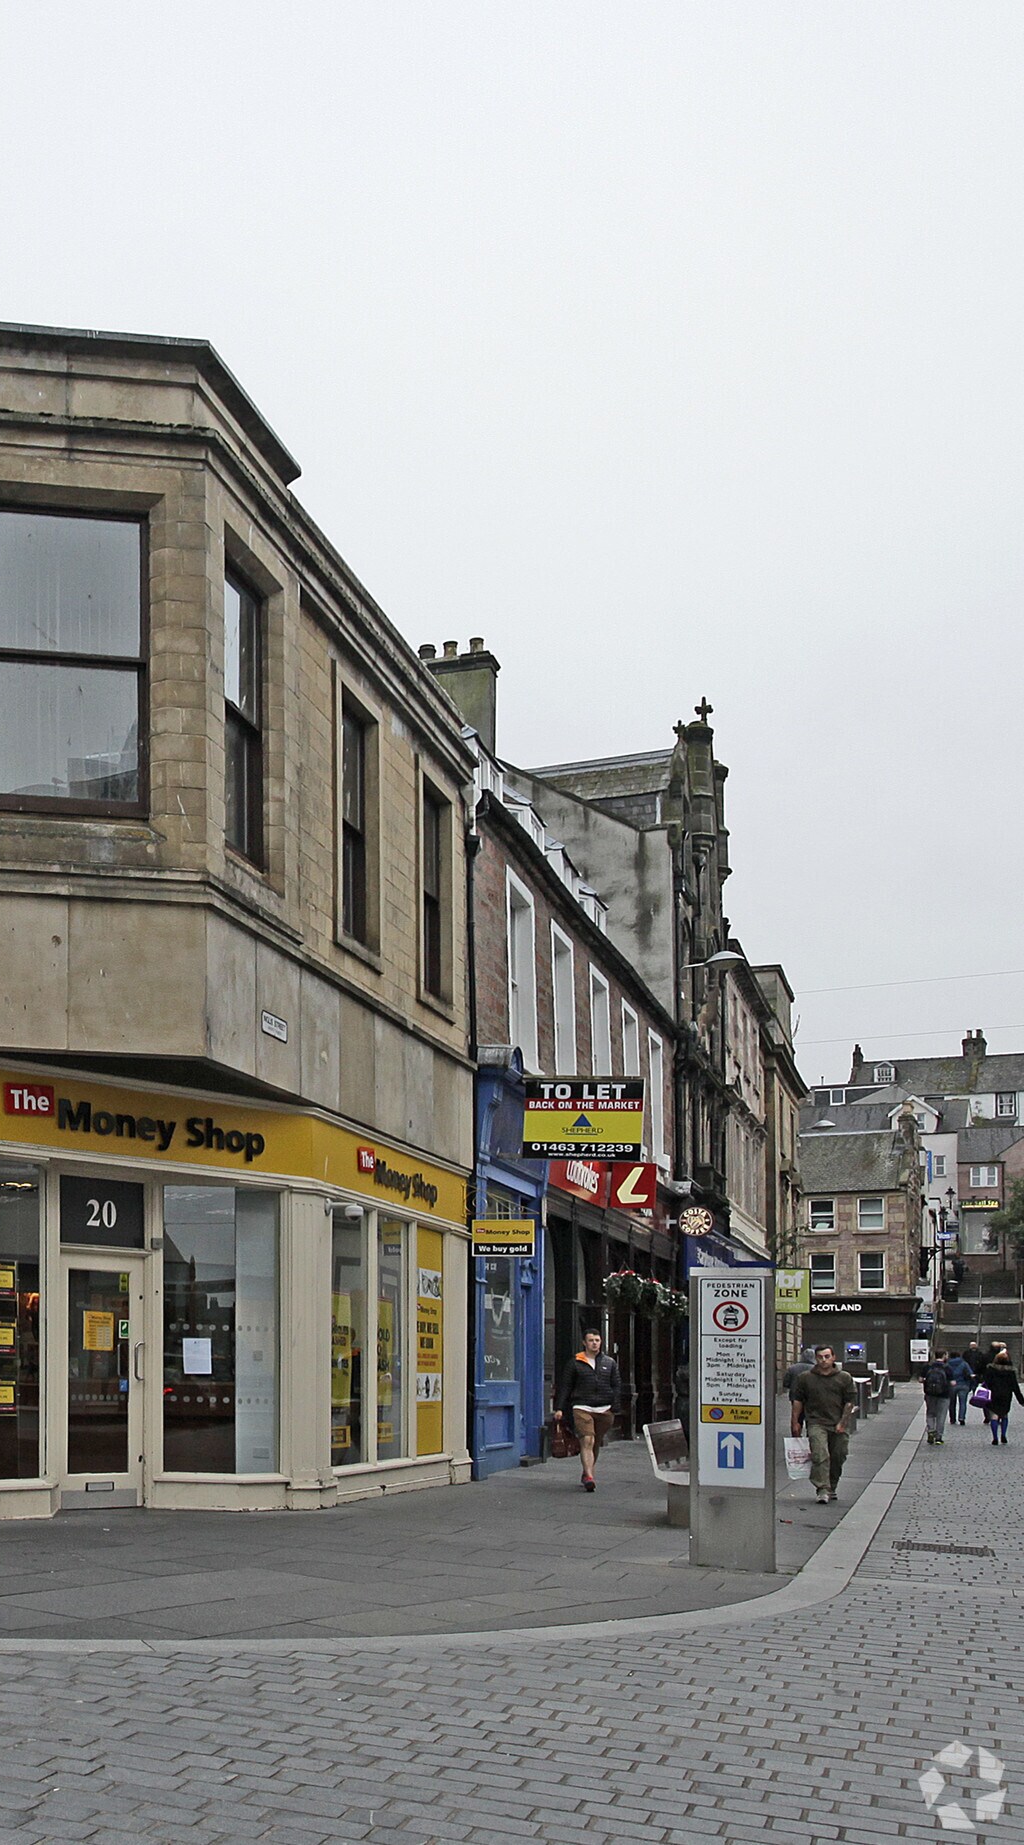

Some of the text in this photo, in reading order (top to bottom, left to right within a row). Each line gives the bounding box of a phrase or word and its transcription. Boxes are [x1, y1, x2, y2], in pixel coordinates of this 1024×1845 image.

[540, 1084, 626, 1100] TO LET
[529, 1101, 640, 1110] BACK ON THE MARKET
[10, 1089, 265, 1162] The Money Shop
[531, 1143, 634, 1153] 01463 712239
[361, 1151, 438, 1208] The Money Shop
[86, 1199, 117, 1228] 20
[683, 1207, 708, 1218] COSTA
[681, 1222, 710, 1235] COFFEE
[492, 1245, 508, 1254] buy
[509, 1245, 528, 1254] gold
[714, 1289, 748, 1298] ZONE
[779, 1288, 800, 1298] LET
[811, 1304, 862, 1312] SCOTLAND
